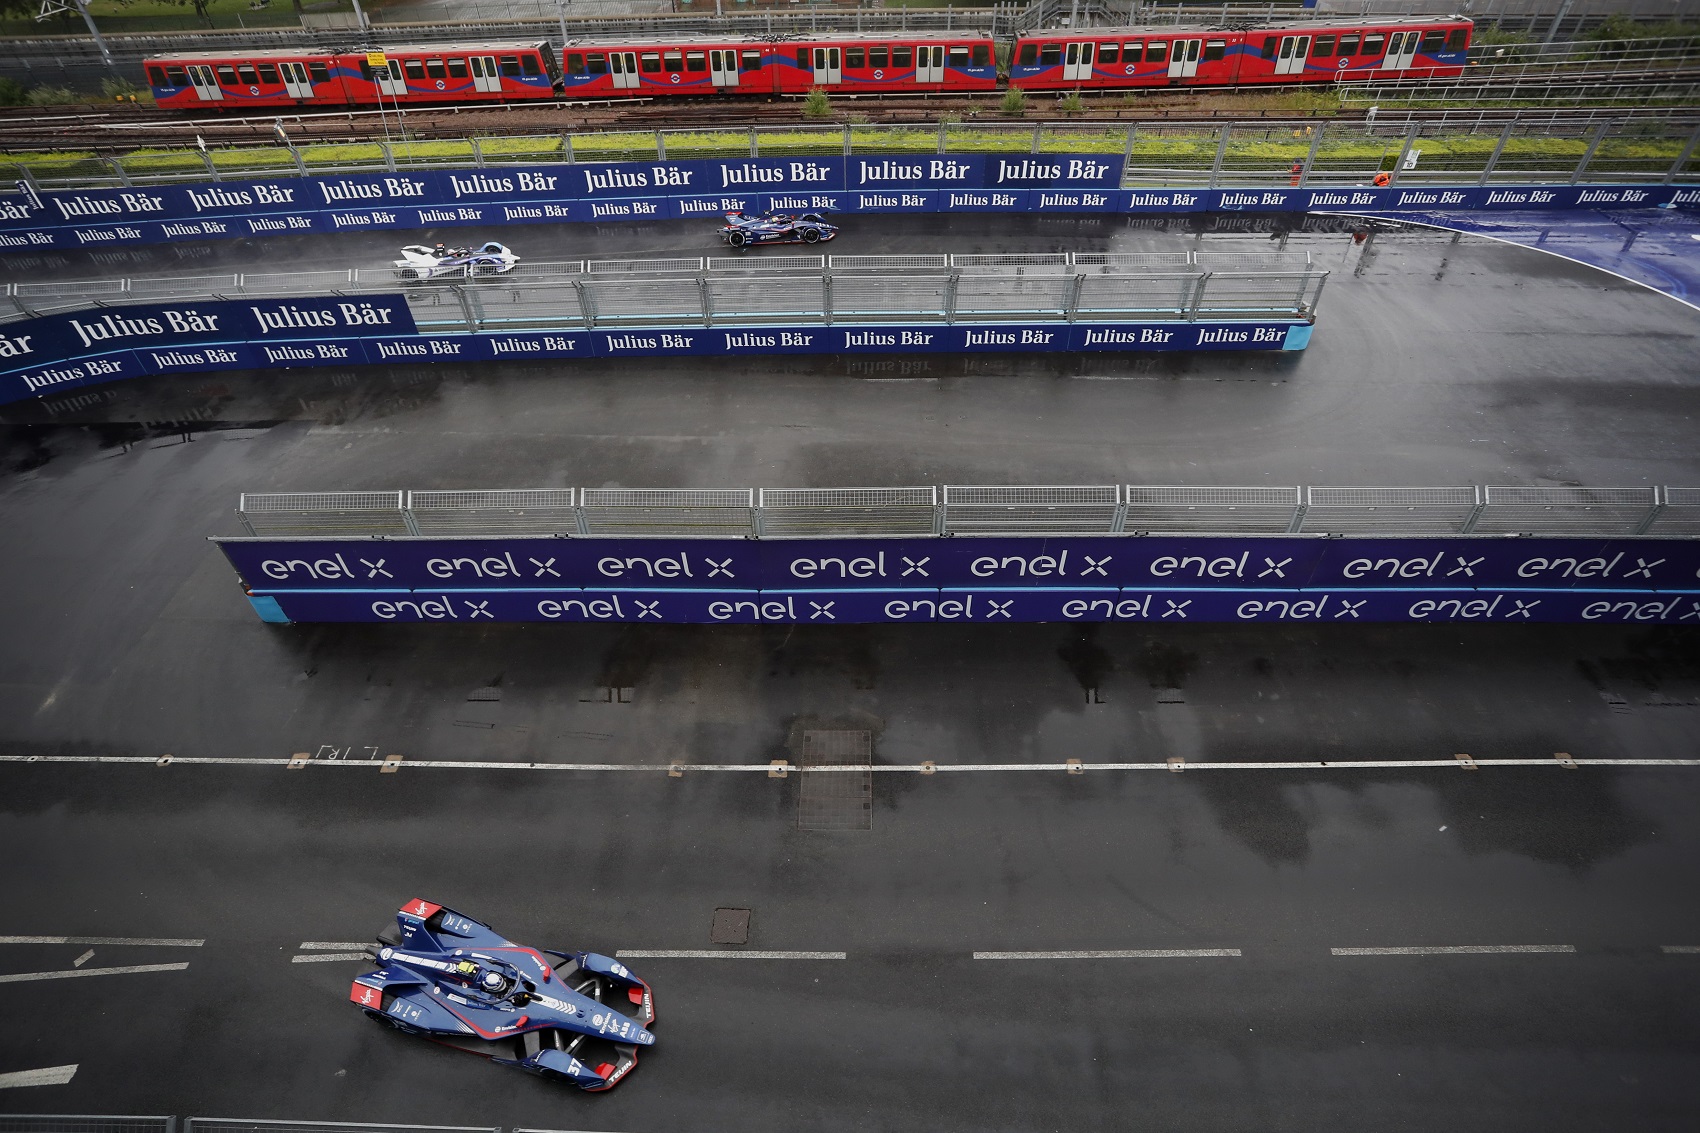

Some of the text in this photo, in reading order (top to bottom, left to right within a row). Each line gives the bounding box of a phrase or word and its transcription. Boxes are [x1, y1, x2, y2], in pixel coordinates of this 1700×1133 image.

[584, 167, 692, 193] Julius Bär
[721, 163, 830, 187] Julius Bär
[860, 161, 970, 184] Julius Bär
[998, 160, 1109, 183] Julius Bär
[318, 178, 424, 204] Julius Bär
[450, 173, 557, 198] Julius Bär
[53, 194, 163, 219] Julius Bär
[186, 185, 293, 211] Julius Bär
[680, 199, 745, 214] Julius Bär
[770, 196, 836, 211] Julius Bär
[860, 195, 926, 209] Julius Bär
[950, 194, 1017, 207] Julius Bär
[1040, 194, 1107, 208] Julius Bär
[1130, 194, 1197, 208] Julius Bär
[1219, 193, 1287, 207] Julius Bär
[1308, 193, 1376, 207] Julius Bär
[1397, 192, 1466, 206] Julius Bär
[1485, 191, 1556, 205] Julius Bär
[1576, 190, 1648, 204] Julius Bär
[1668, 190, 1700, 205] Juli
[418, 209, 482, 224] Julius Bär
[504, 205, 568, 221] Julius Bär
[591, 202, 657, 218] Julius Bär
[247, 217, 311, 233] Julius Bär
[332, 212, 395, 228] Julius Bär
[0, 233, 54, 246] lius Bär
[75, 228, 141, 243] Julius Bär
[161, 222, 226, 238] Julius Bär
[251, 303, 391, 333] Julius Bär
[69, 311, 219, 347] Julius Bär
[965, 330, 1054, 347] Julius Bär
[1084, 329, 1173, 346] Julius Bär
[1196, 328, 1287, 345] Julius Bär
[0, 333, 34, 358] är
[377, 341, 461, 358] Julius Bär
[490, 337, 575, 355] Julius Bär
[606, 335, 693, 351] Julius Bär
[725, 333, 813, 349] Julius Bär
[845, 332, 933, 348] Julius Bär
[152, 350, 237, 369] Julius Bär
[264, 345, 348, 363] Julius Bär
[21, 360, 122, 391] Julius Bär
[262, 553, 354, 579] enel
[427, 552, 521, 577] enel
[598, 552, 693, 577] enel
[791, 552, 886, 578] enel
[971, 550, 1067, 576] enel
[1150, 551, 1249, 577] enel
[1344, 552, 1444, 578] enel
[1518, 553, 1624, 577] enel
[372, 596, 457, 618] enel
[538, 595, 624, 618] enel
[709, 597, 796, 619] enel
[885, 595, 972, 618] enel
[1063, 595, 1152, 617] enel
[1237, 595, 1328, 618] enel
[1409, 595, 1503, 617] enel
[1582, 598, 1680, 619] enel
[567, 1058, 582, 1077] 37
